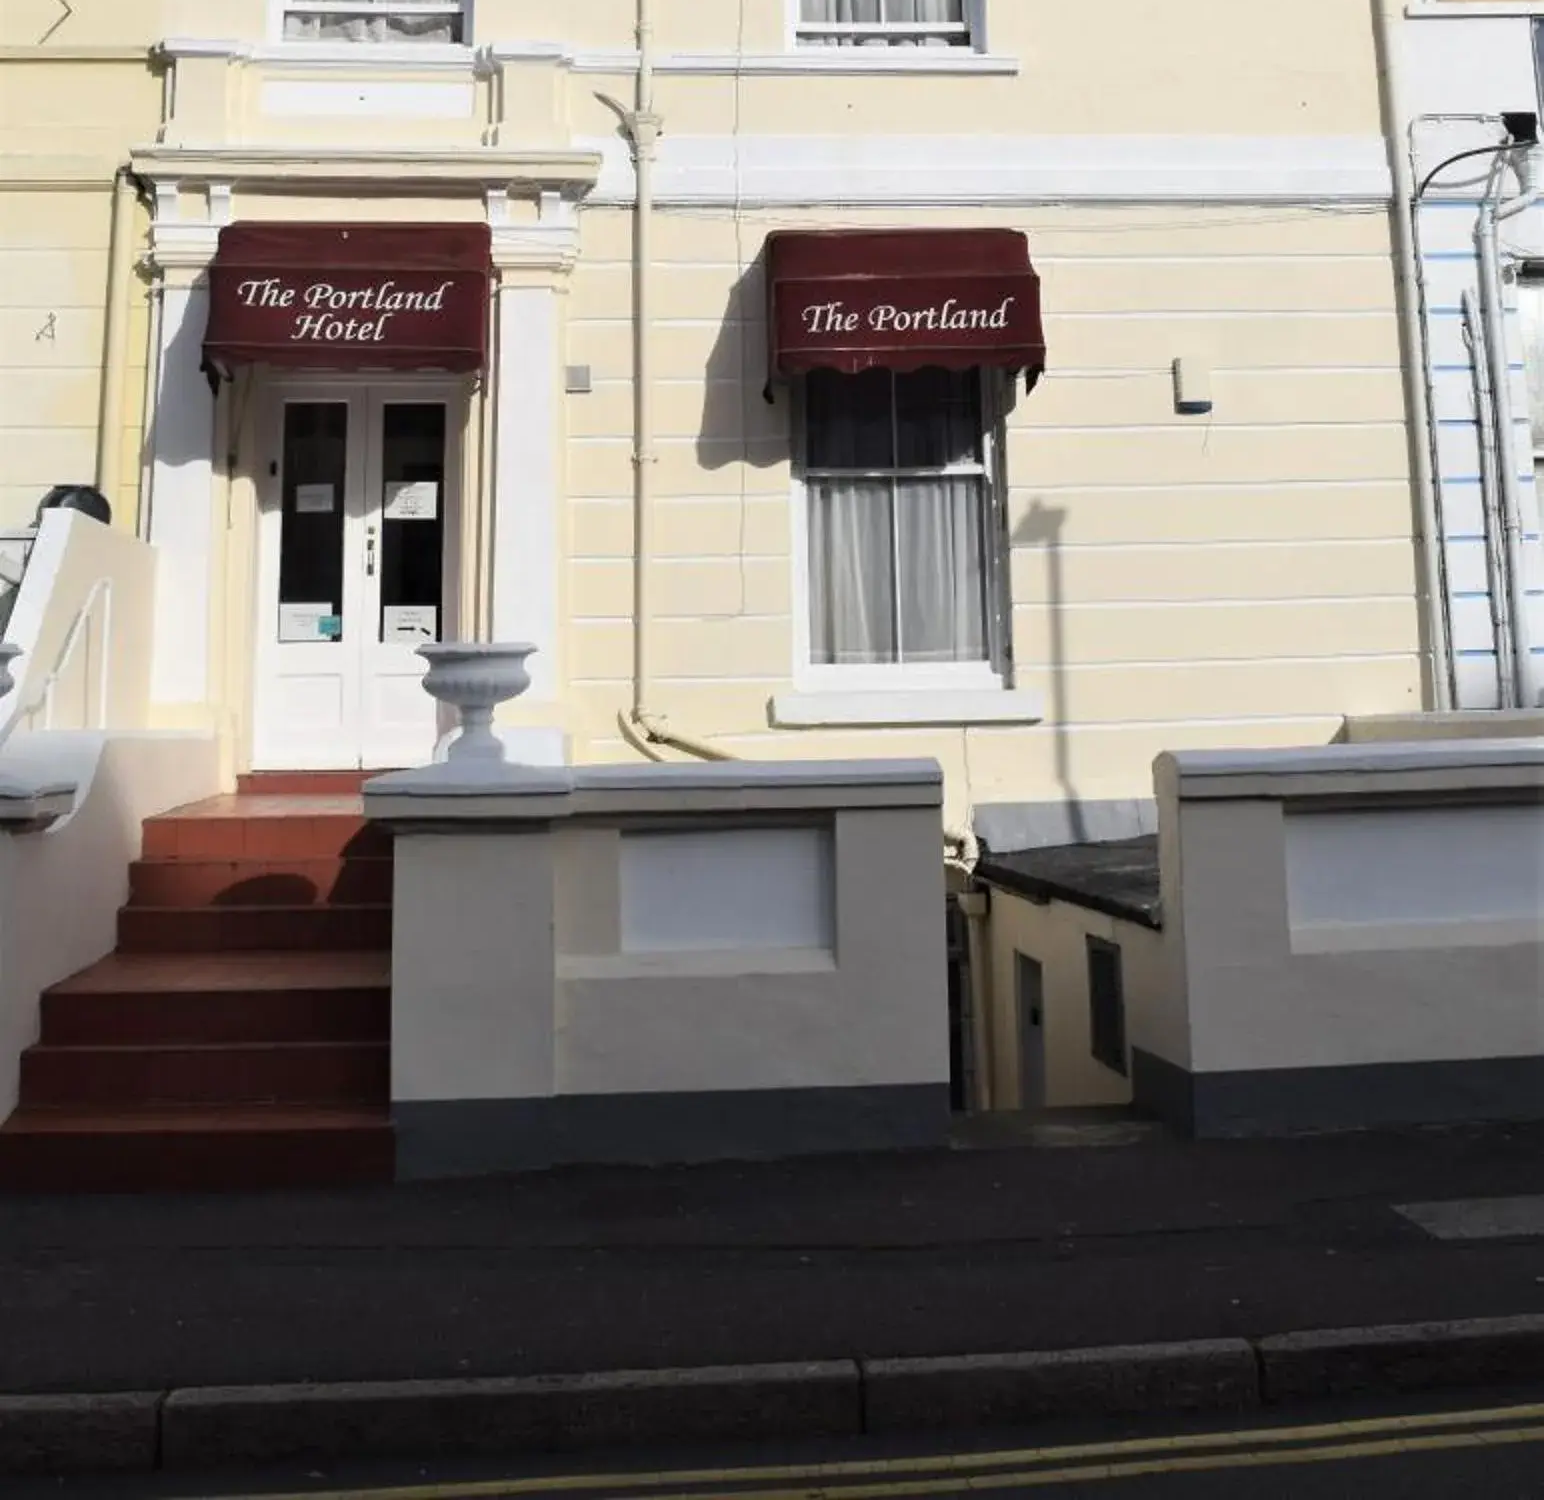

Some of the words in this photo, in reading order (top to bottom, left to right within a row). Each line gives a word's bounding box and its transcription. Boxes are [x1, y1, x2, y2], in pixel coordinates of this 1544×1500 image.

[238, 279, 296, 307] The
[303, 282, 454, 312] Portland
[291, 313, 394, 341] Hotel
[801, 302, 858, 333] The
[867, 297, 1014, 331] Portland
